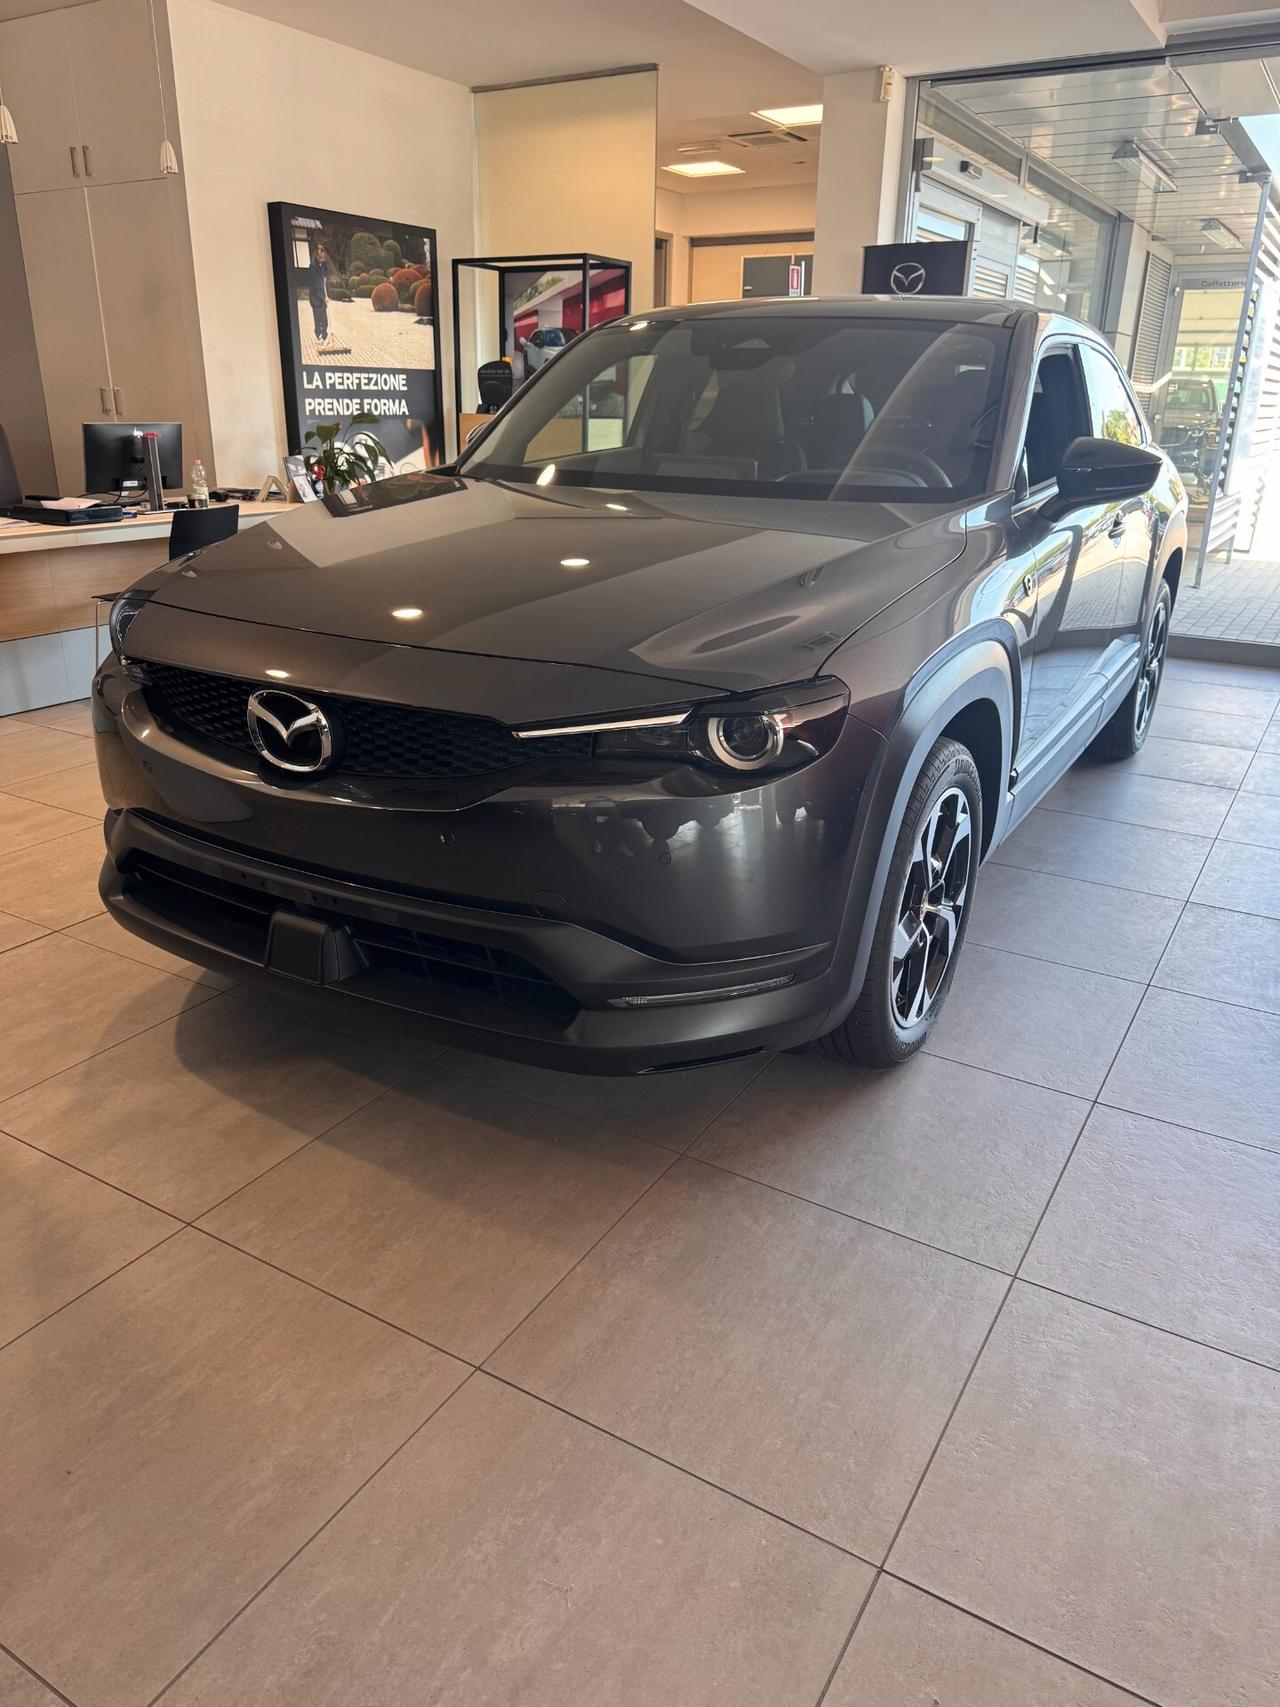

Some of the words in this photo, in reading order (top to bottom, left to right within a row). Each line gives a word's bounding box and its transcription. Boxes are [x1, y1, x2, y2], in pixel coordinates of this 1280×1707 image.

[303, 371, 323, 389] LA
[325, 372, 408, 391] PERFEZIONE
[305, 398, 361, 416] PRENDE
[363, 398, 409, 416] FORMA
